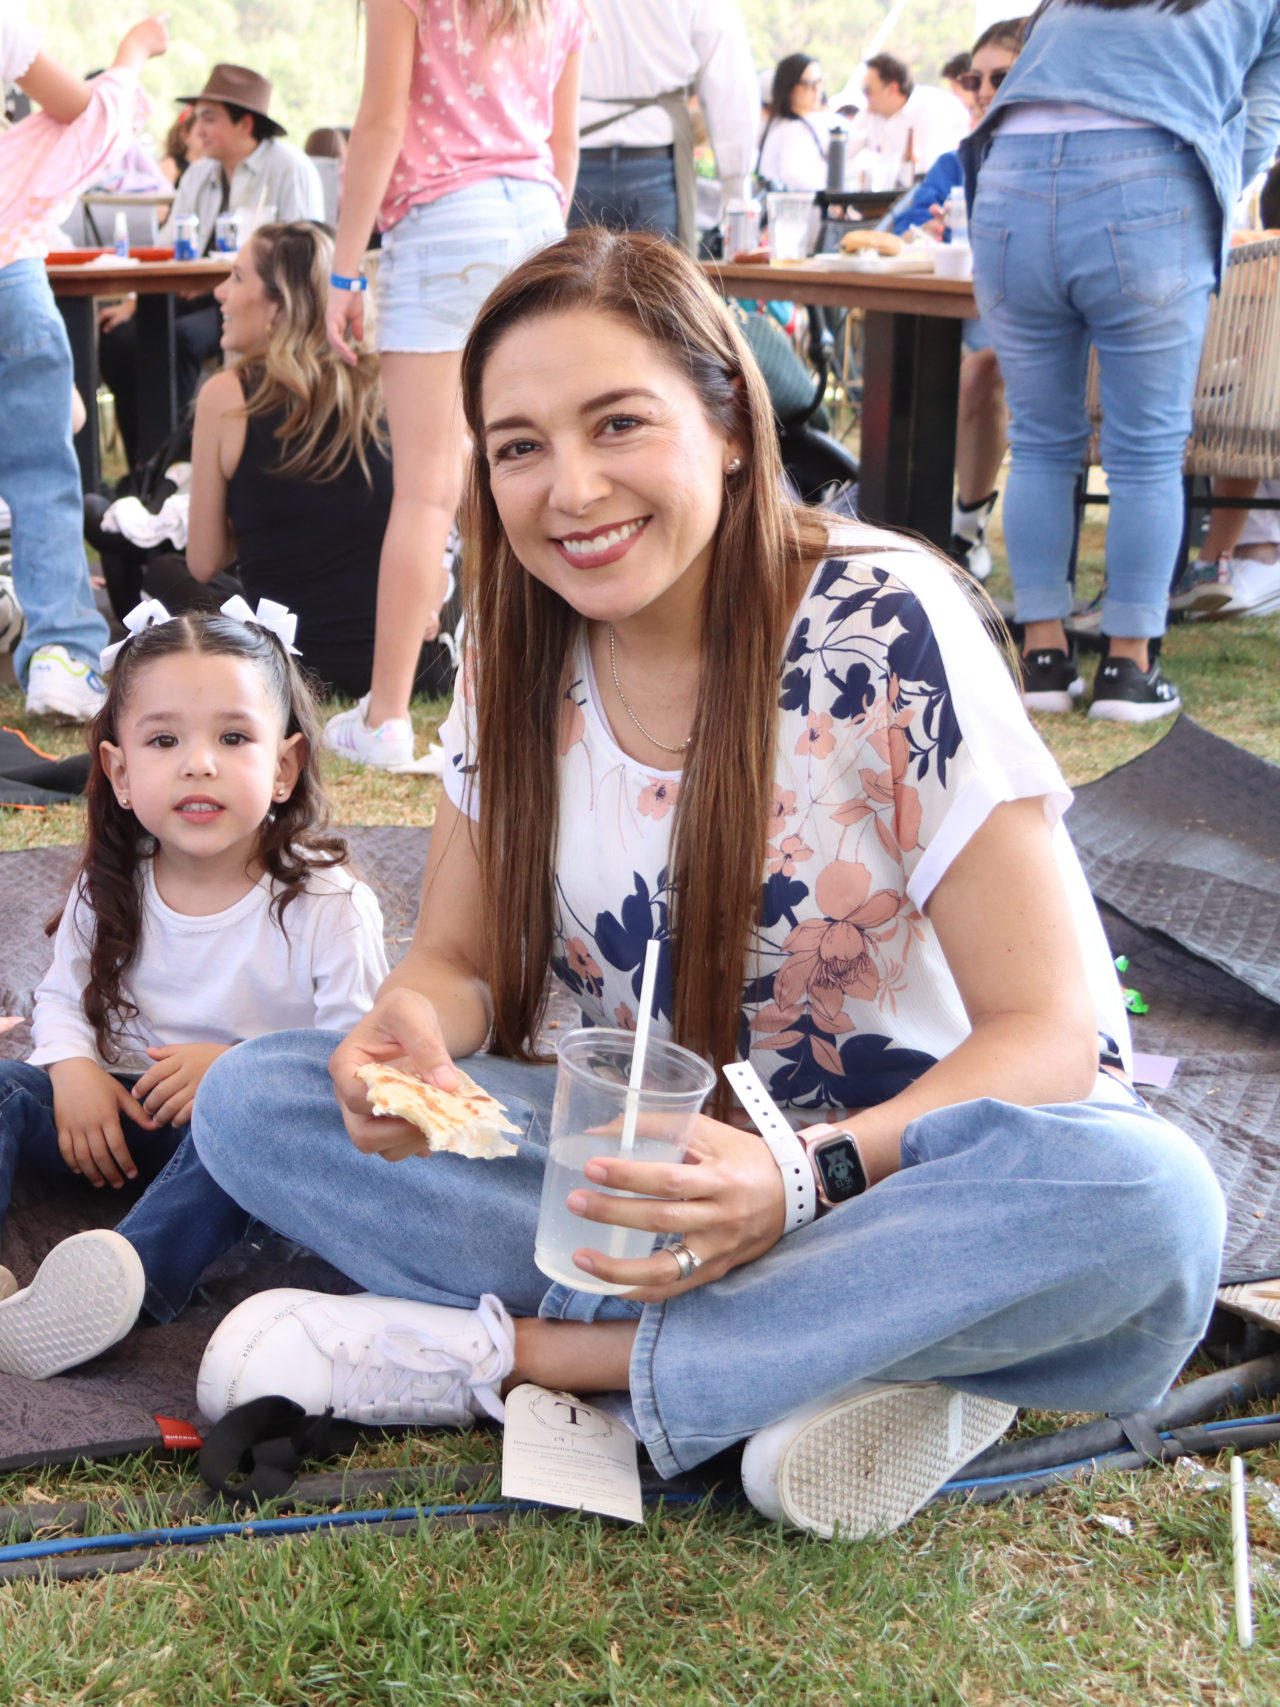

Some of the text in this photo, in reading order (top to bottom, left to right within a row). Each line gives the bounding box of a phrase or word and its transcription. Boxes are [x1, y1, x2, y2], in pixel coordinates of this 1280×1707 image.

[241, 1329, 264, 1358] HILFIGER
[226, 1379, 237, 1411] HILFIGE
[554, 1401, 591, 1427] T
